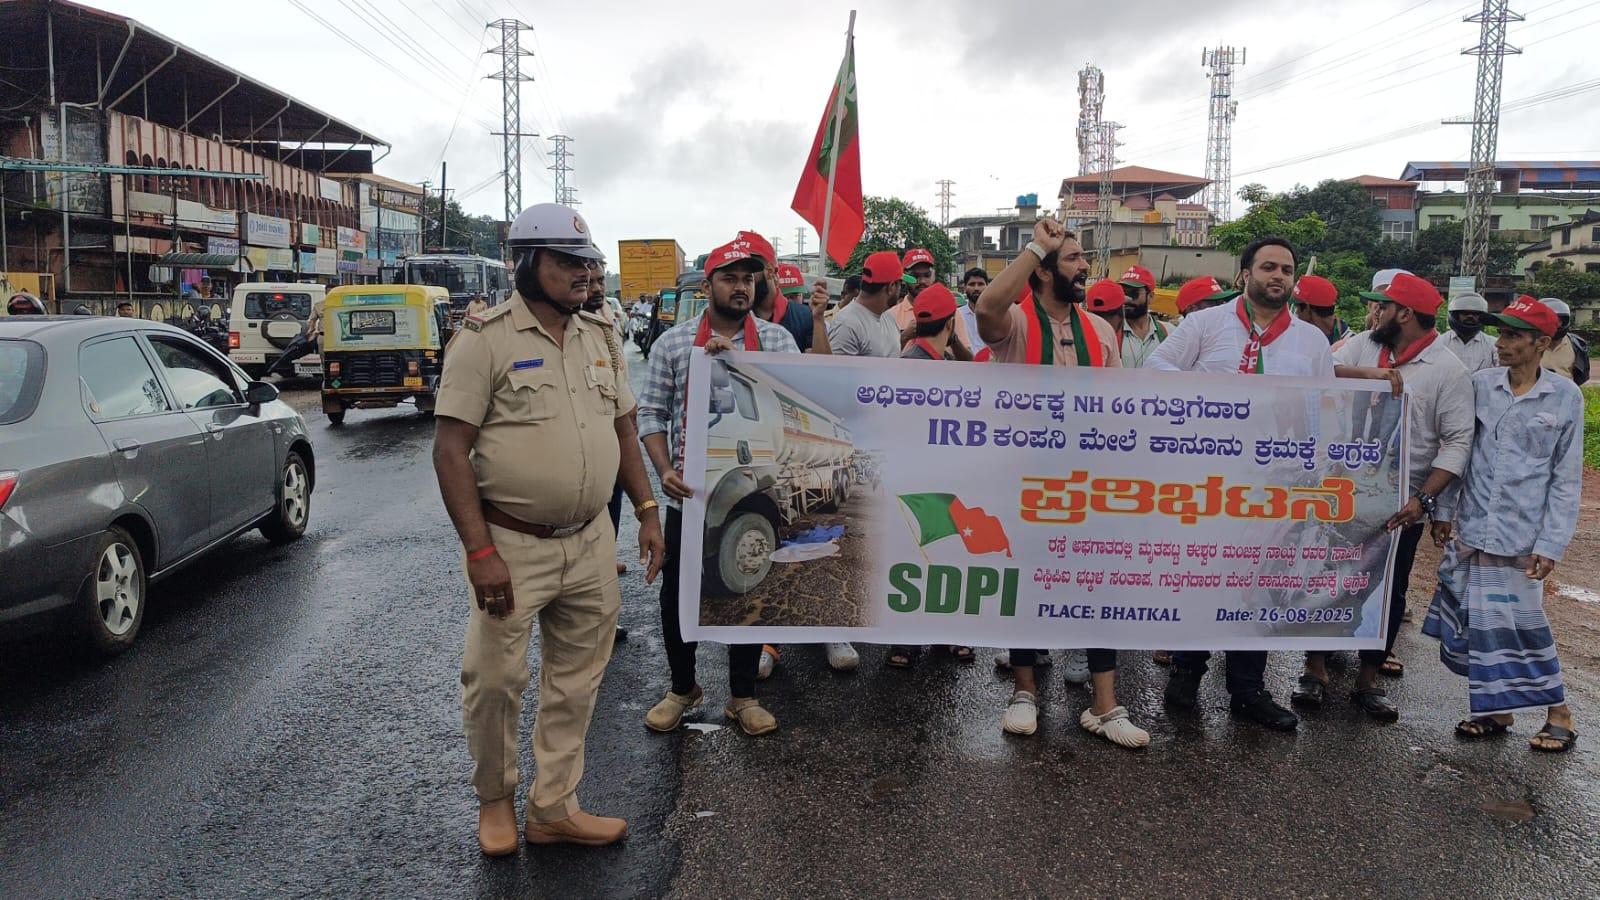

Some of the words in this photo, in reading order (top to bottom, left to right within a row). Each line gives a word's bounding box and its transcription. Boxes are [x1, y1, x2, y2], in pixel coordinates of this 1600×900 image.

[857, 385, 981, 408] ಅಧಿಕಾರಿಗಳ
[1074, 396, 1104, 413] NH
[1111, 397, 1136, 415] 66
[1141, 393, 1251, 425] ಗುತ್ತಿಗೆದಾರ
[928, 418, 988, 447] IRB
[993, 424, 1066, 449] ಕಂಪನಿ
[1079, 427, 1137, 452] ಮೇಲೆ
[1150, 432, 1243, 456] ಕಾನೂನು
[1255, 436, 1316, 471] ಕ್ರಮಕ್ಕೆ
[1327, 438, 1380, 469] ಆಗ್ರಹ
[1020, 470, 1356, 525] ಪ್ರತಿಭಟನೆ
[1048, 536, 1067, 559] ರಸ್ತೆ
[887, 562, 1020, 617] SDPI
[1226, 571, 1254, 589] ಮೇಲೆ
[1258, 573, 1304, 590] ಕಾನೂನು
[1037, 604, 1095, 620] PLACE:
[1101, 605, 1181, 622] BHATKAL
[1216, 608, 1254, 622] Date:
[1258, 608, 1354, 624] 26-08-2025
